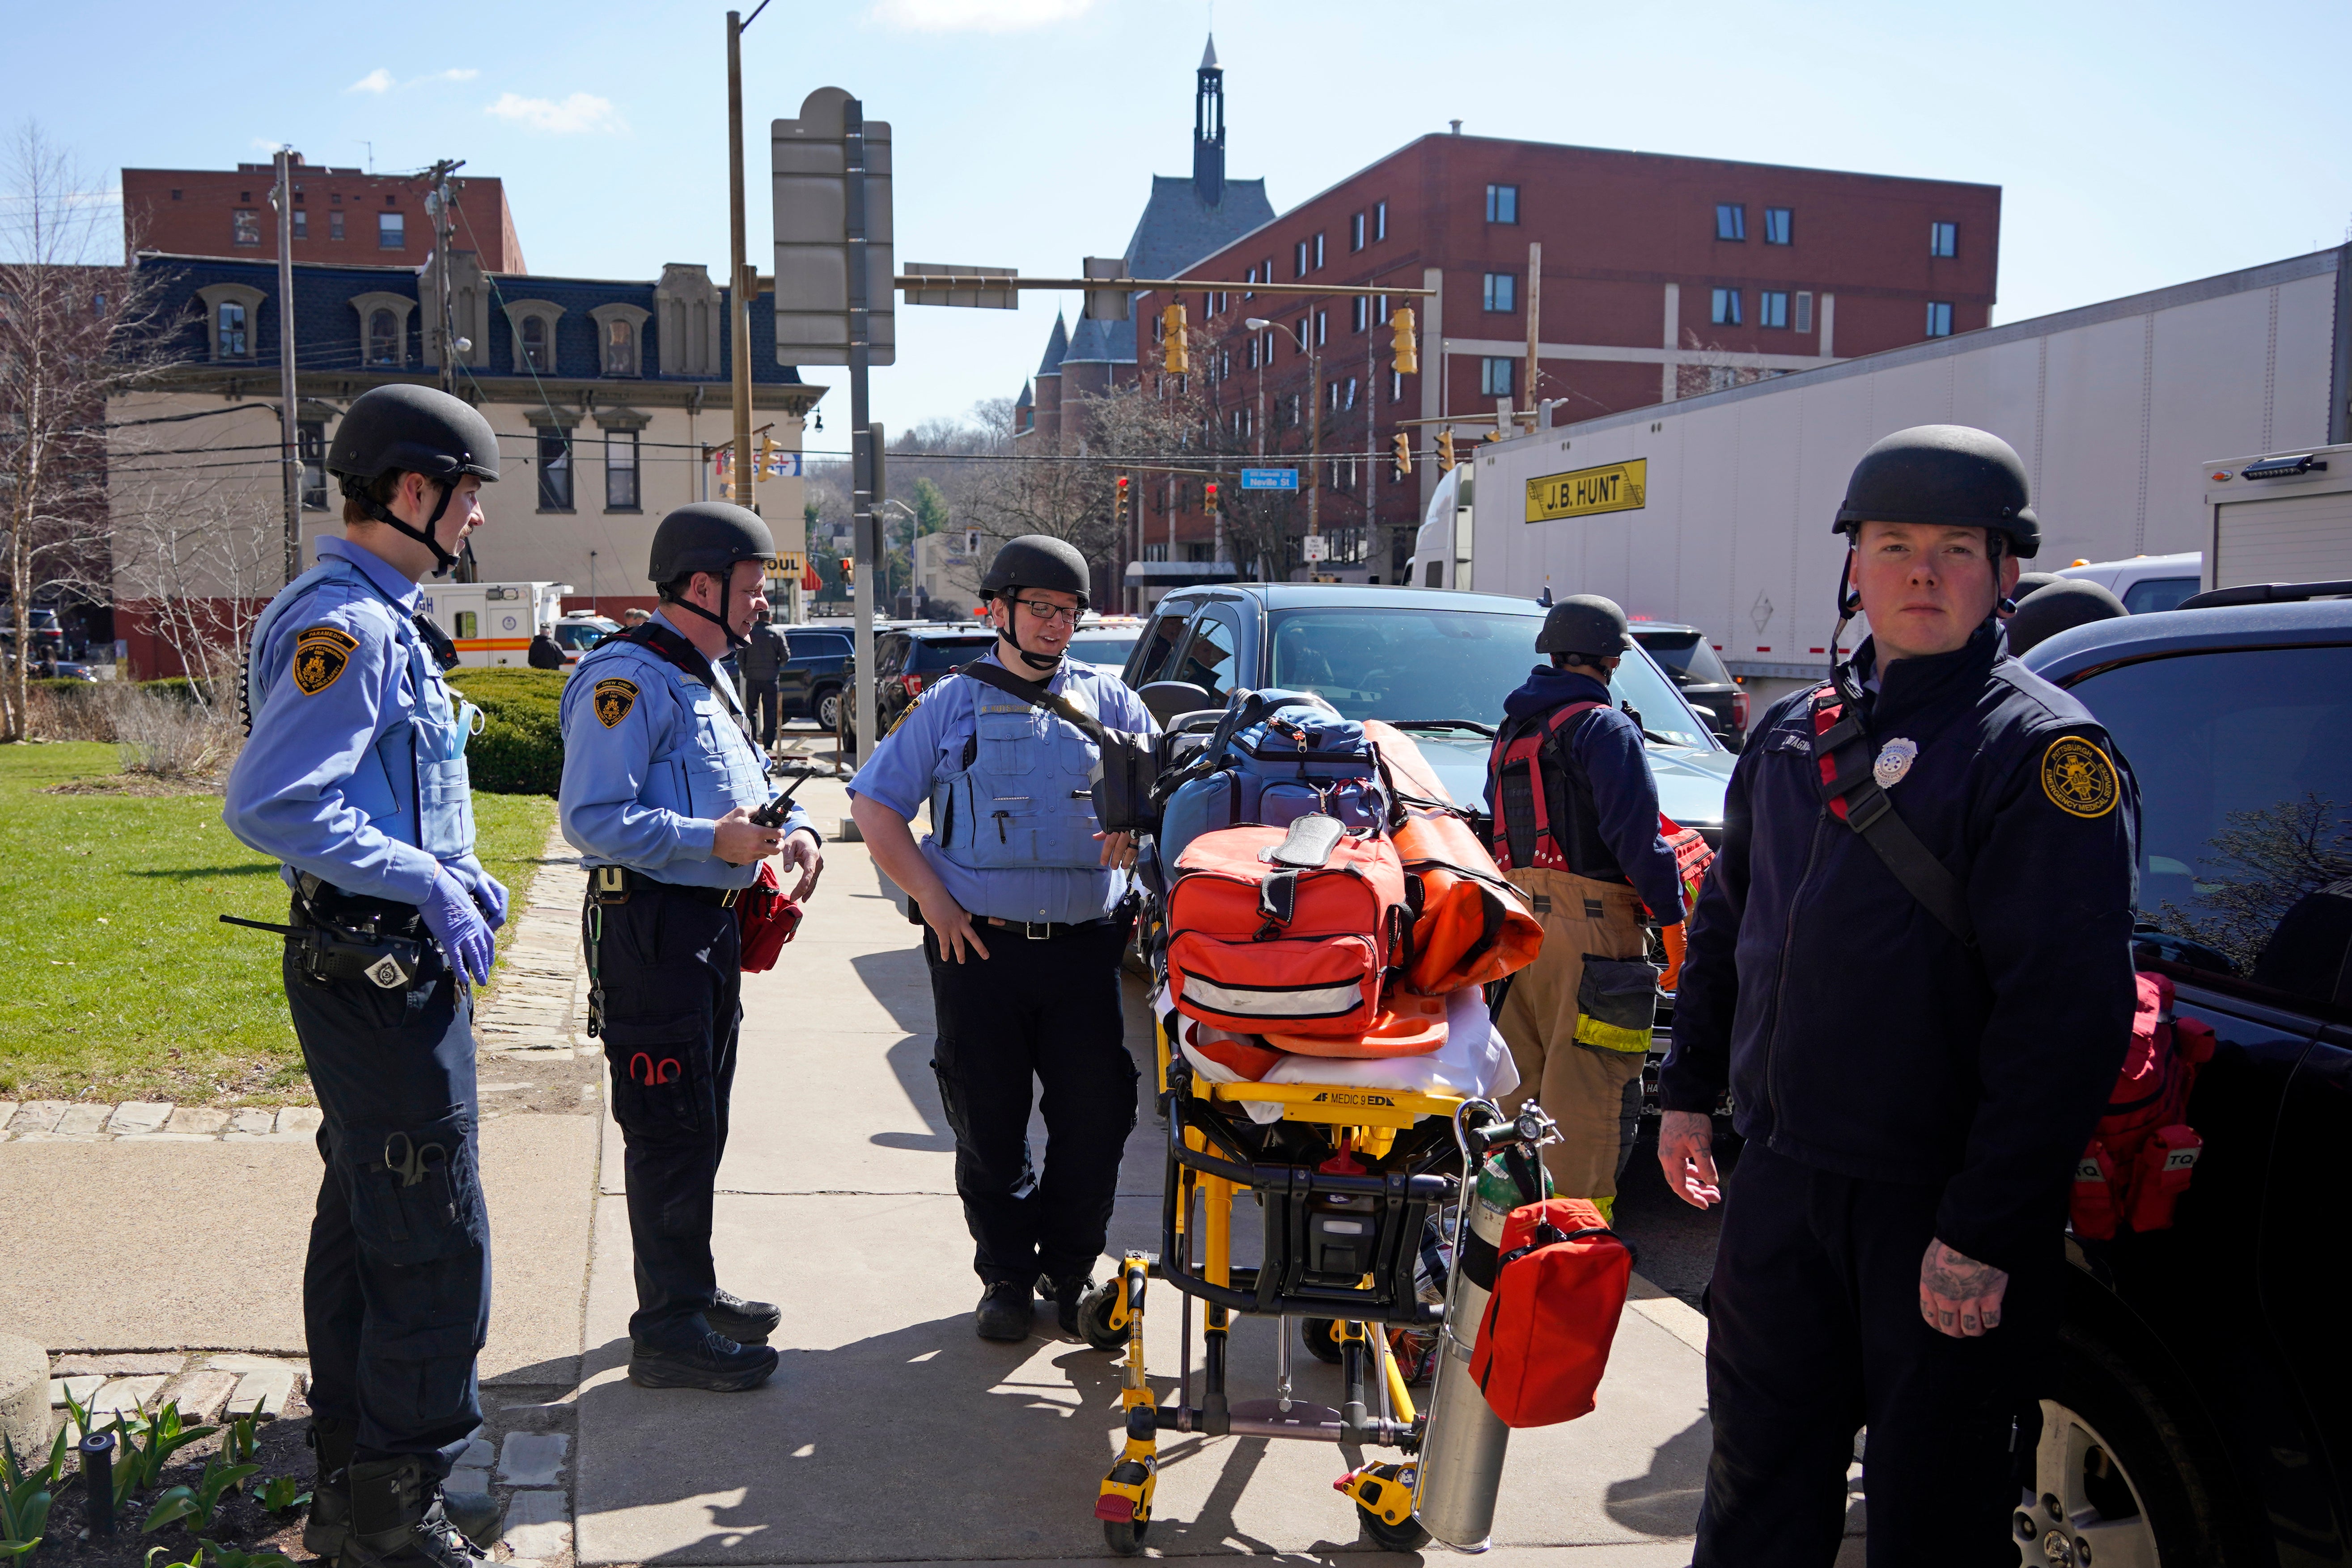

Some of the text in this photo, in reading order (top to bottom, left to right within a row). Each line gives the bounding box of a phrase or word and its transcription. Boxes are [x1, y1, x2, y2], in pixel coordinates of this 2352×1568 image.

[1250, 478, 1289, 486] Neville St
[1577, 474, 1620, 506] HUNT
[763, 559, 799, 570] OUL
[309, 631, 344, 641] PARAMEDIC
[316, 646, 344, 661] PITTSBURGH
[312, 664, 342, 689] PUBLIC SAFETY
[2051, 744, 2093, 760] PITTSBURGH
[1894, 750, 1909, 768] PITTSBURGH
[1877, 768, 1901, 778] PARAMEDICS
[2046, 763, 2112, 811] EMERGENCY MEDICAL SERVICES
[1331, 1093, 1358, 1105] MEDIC
[1361, 1095, 1365, 1105] 9
[2170, 1155, 2193, 1165] TQ
